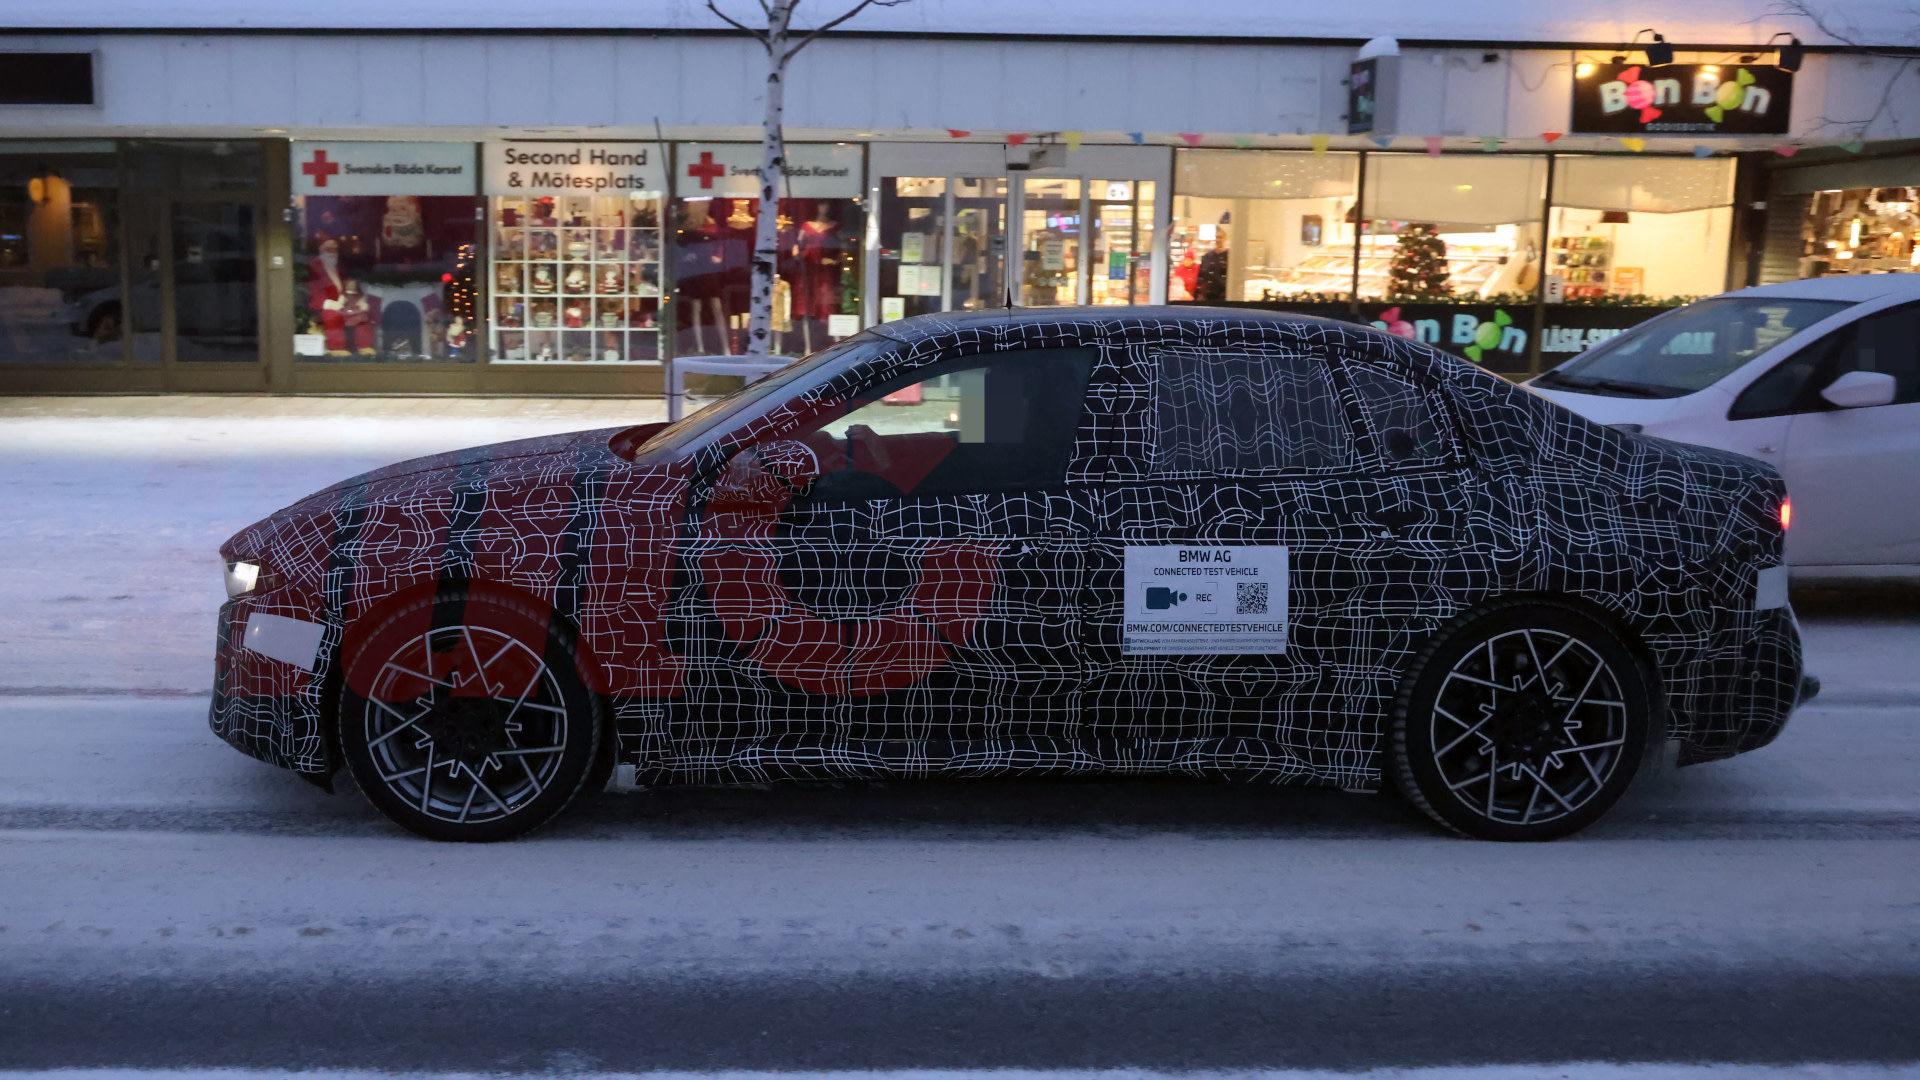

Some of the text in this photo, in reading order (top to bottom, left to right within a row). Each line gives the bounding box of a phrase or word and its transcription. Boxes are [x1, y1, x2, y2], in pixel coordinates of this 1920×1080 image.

[1600, 71, 1771, 118] Bon Bon
[505, 148, 648, 166] Second Hand
[344, 163, 463, 175] Svenska Röda Korset
[813, 166, 849, 177] Korset
[508, 171, 645, 192] & Mötesplats
[1370, 313, 1528, 354] on Bon
[1179, 550, 1232, 563] BMW AG
[1154, 567, 1259, 576] CONNECTED TEST VEHICLE
[1196, 593, 1212, 602] REC
[1126, 623, 1283, 633] BMW.COM/CONNECTEDTESTVEHICLE
